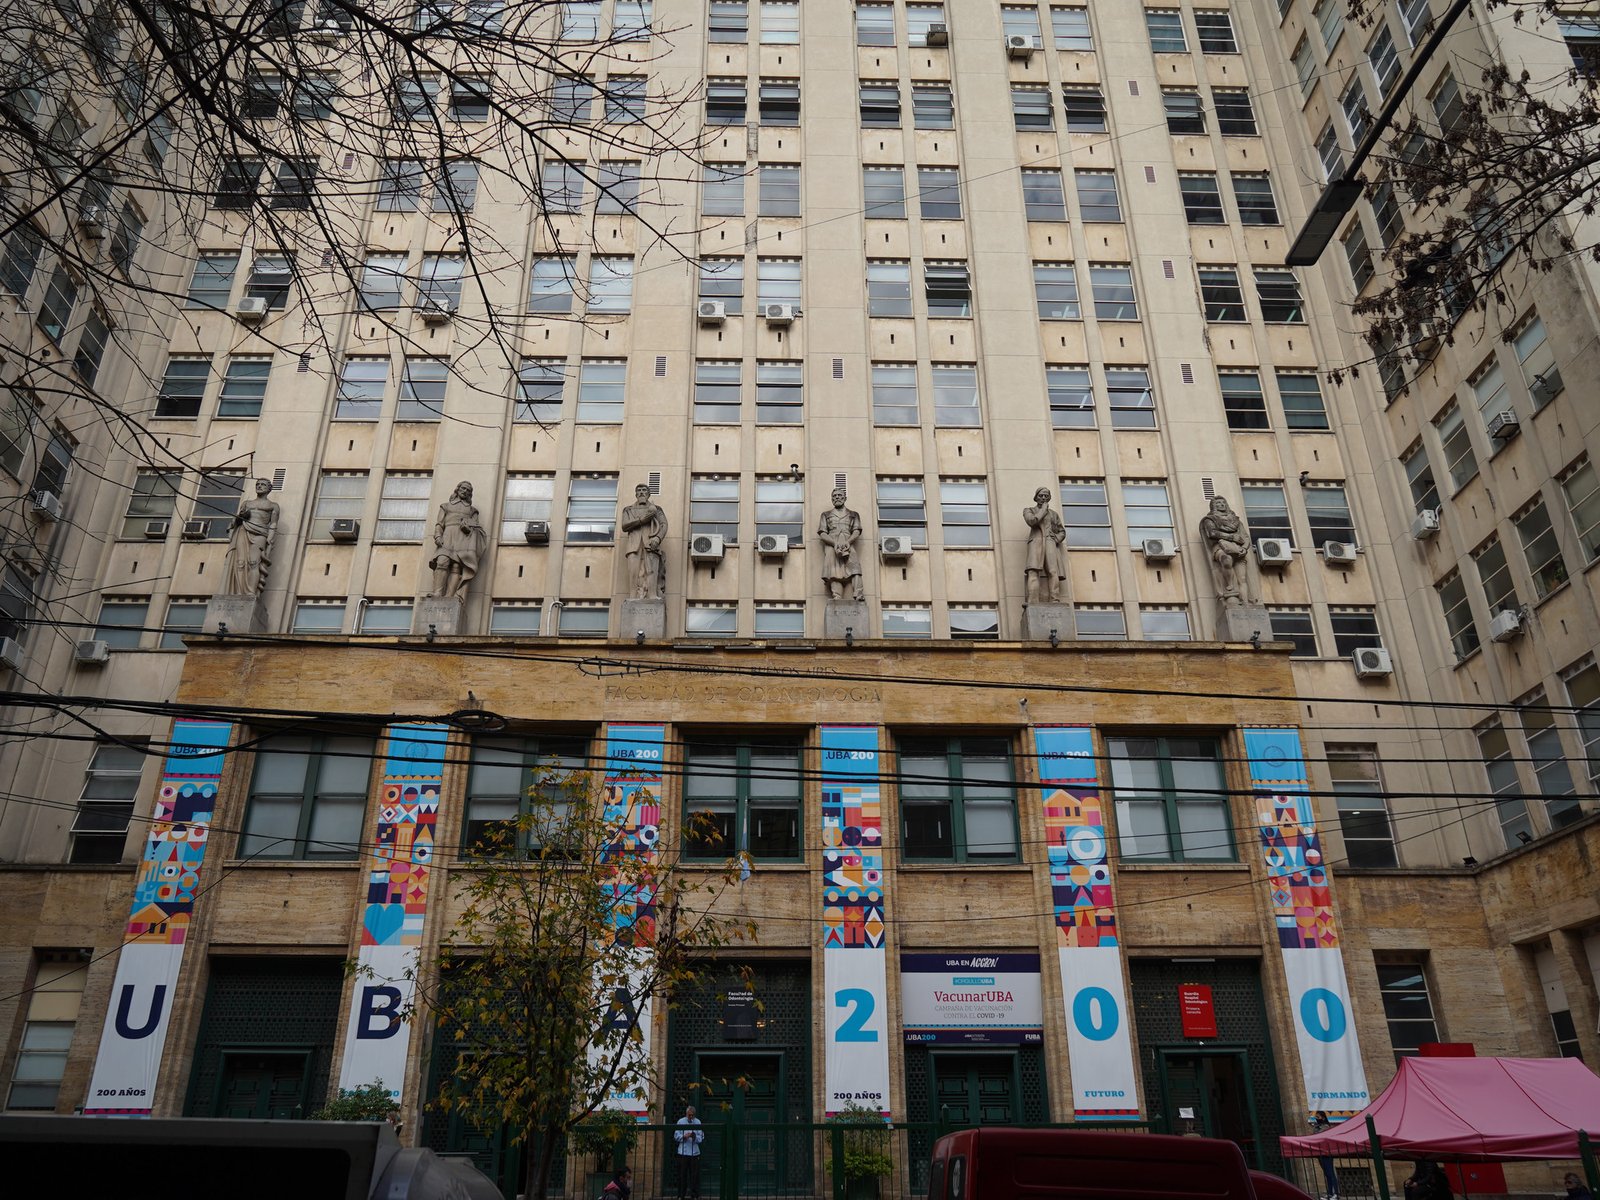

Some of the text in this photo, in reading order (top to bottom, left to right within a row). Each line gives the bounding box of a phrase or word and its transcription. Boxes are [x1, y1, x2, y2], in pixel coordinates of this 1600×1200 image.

[934, 991, 1014, 1002] VacunarUBA
[115, 984, 167, 1040] U
[356, 985, 402, 1040] B
[834, 988, 879, 1042] 2
[97, 1087, 146, 1097] 200 AÑOS
[833, 1090, 882, 1100] 200 AÑOS
[1311, 1091, 1367, 1099] FORMANDO
